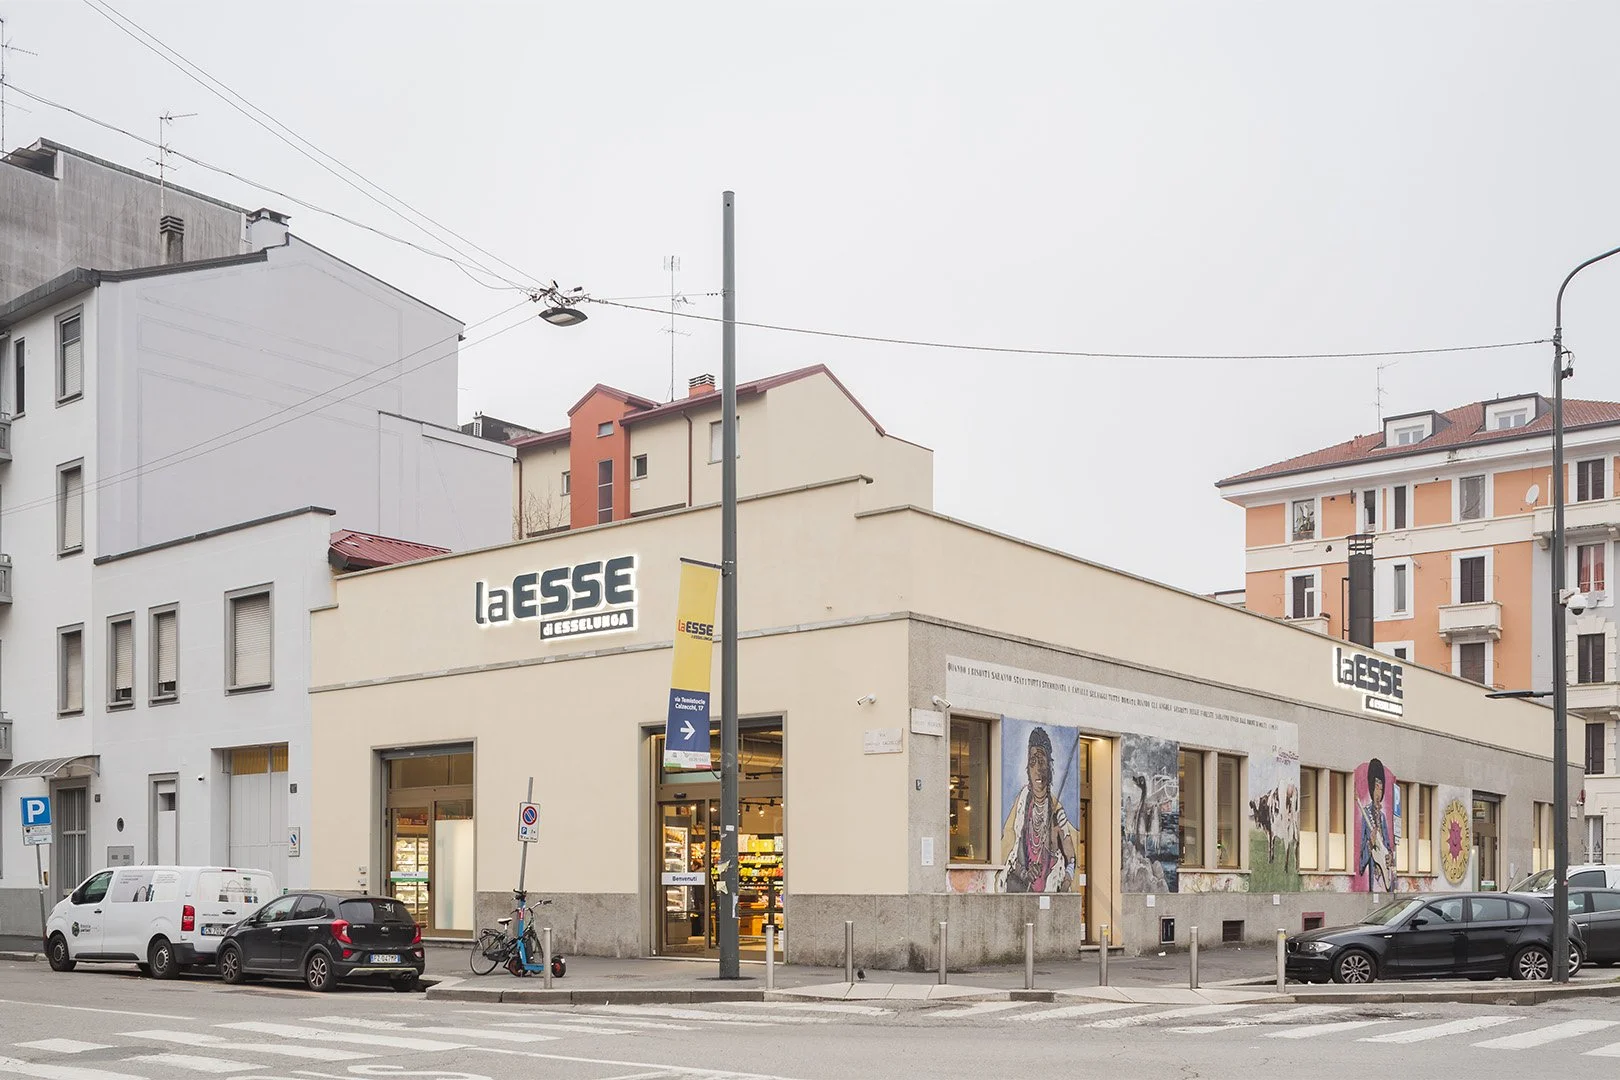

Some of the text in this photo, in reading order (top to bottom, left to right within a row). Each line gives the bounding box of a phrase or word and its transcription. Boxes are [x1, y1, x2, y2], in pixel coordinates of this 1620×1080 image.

[475, 555, 634, 625] laESSE
[554, 612, 628, 634] ESSELUNGA
[677, 619, 714, 636] laESSE
[26, 800, 46, 823] P
